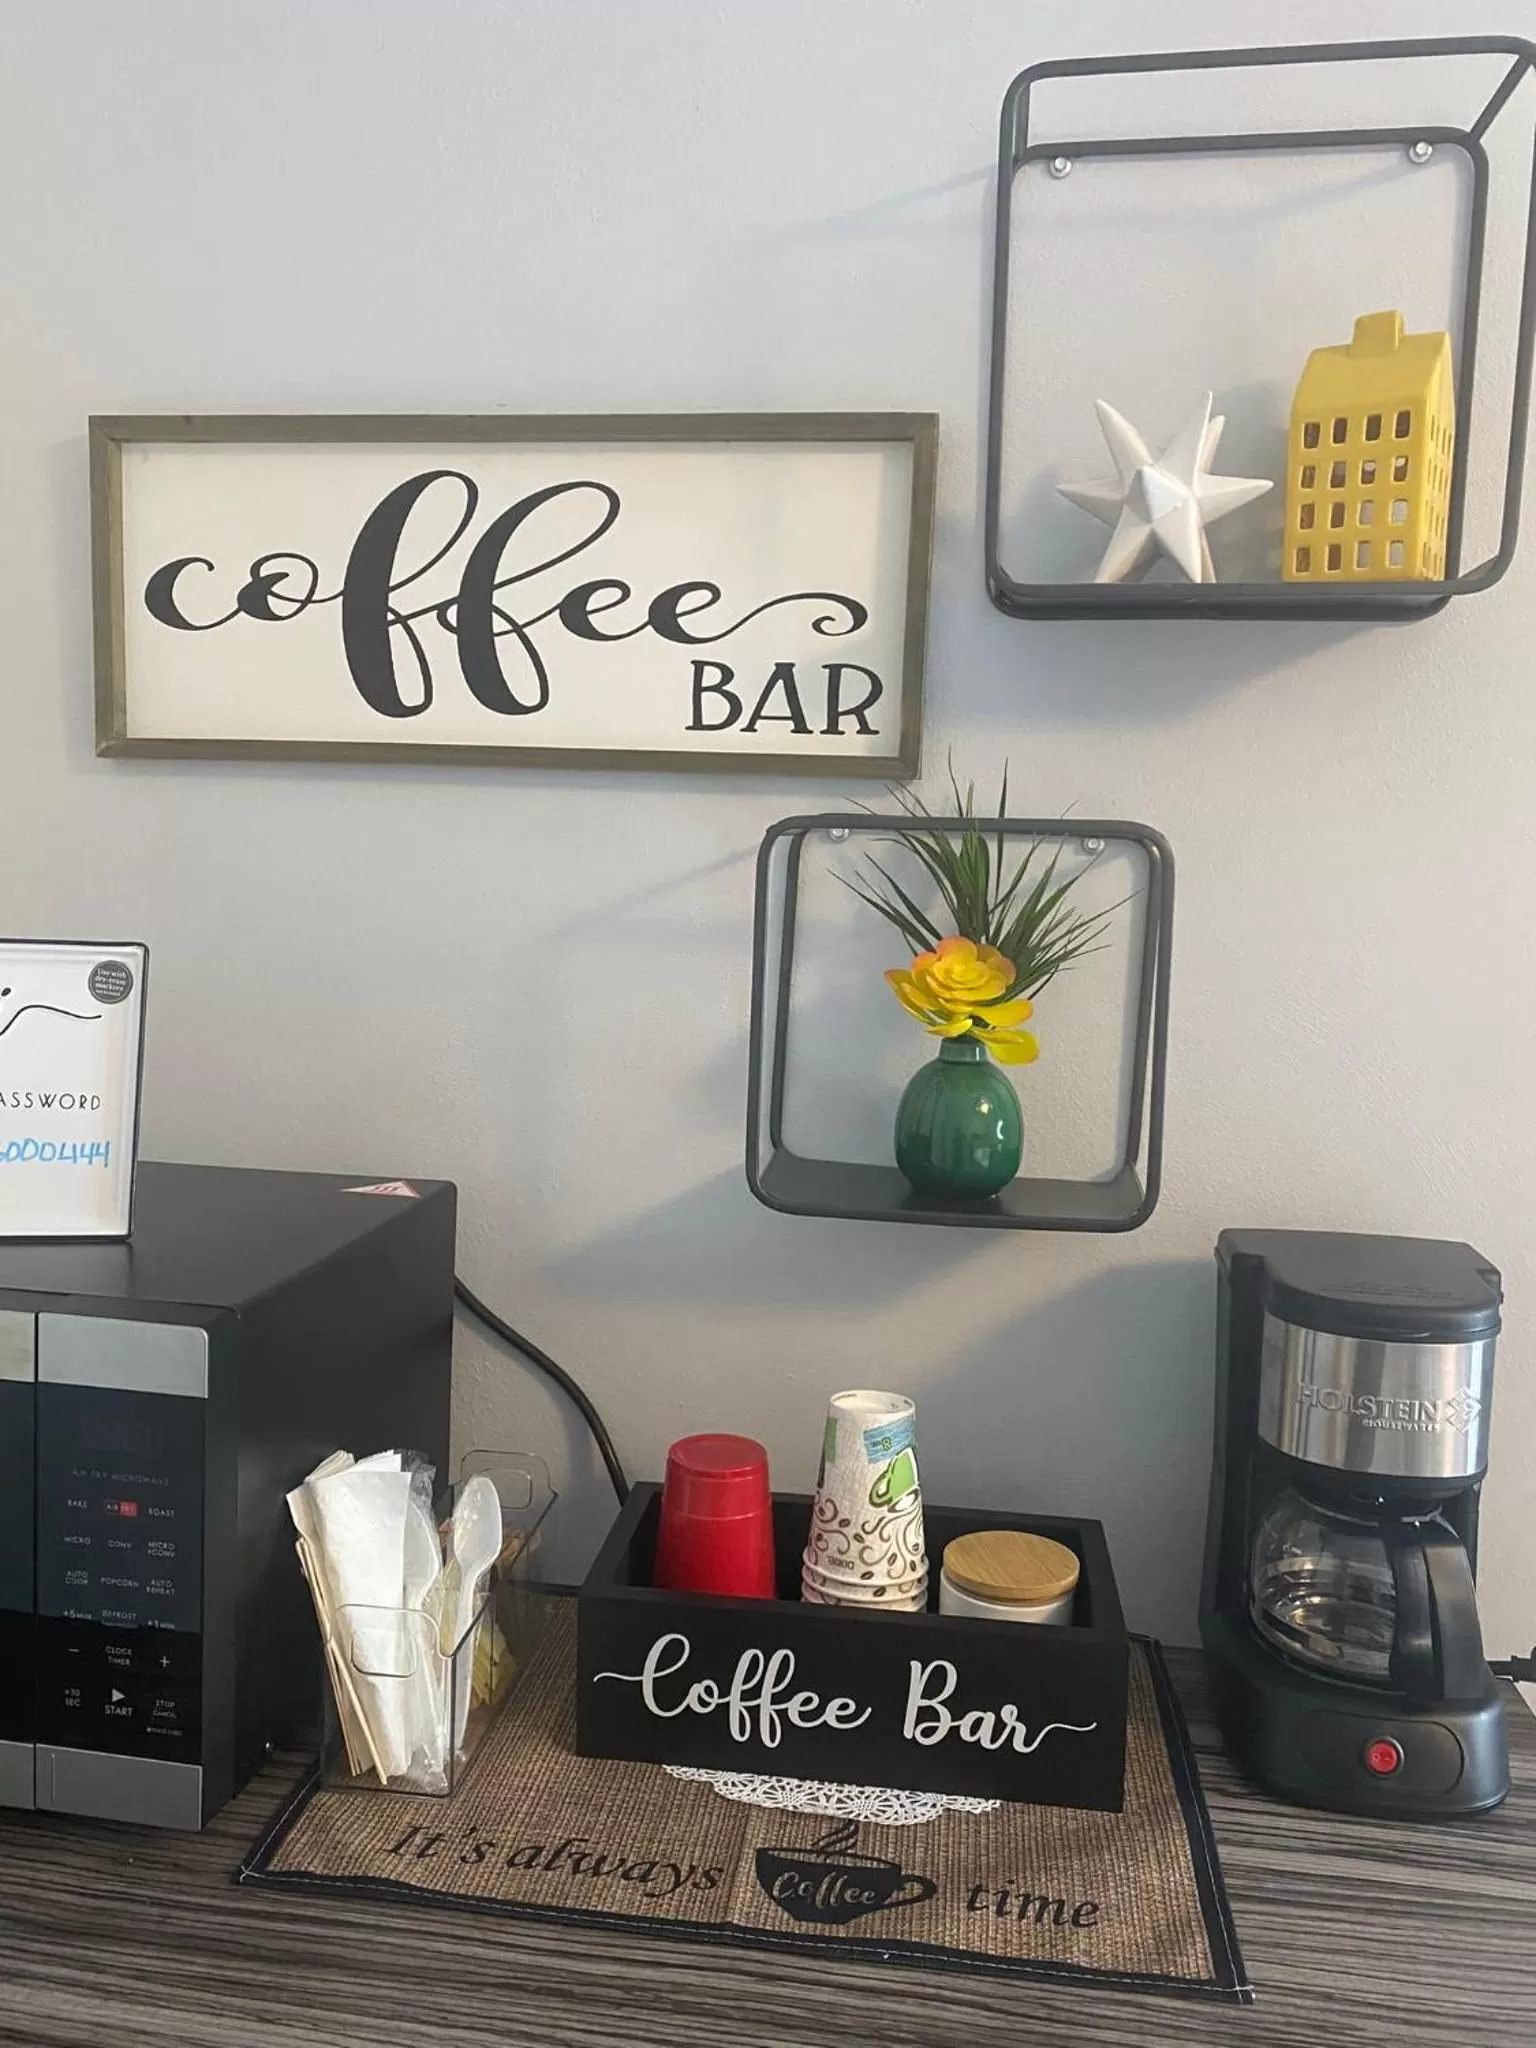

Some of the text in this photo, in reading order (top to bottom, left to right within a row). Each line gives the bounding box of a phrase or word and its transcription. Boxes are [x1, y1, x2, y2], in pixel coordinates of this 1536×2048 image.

[144, 470, 868, 718] coffee
[686, 660, 883, 736] BAR
[1299, 1383, 1441, 1423] HOLSTEIN
[100, 1577, 138, 1588] POPCORN
[101, 1609, 137, 1621] DEFROST
[105, 1646, 132, 1656] CLOCK
[104, 1704, 133, 1718] START
[594, 1633, 1098, 1754] Coffee Bar
[386, 1820, 726, 1898] It's always
[772, 1870, 877, 1910] Coffee
[966, 1880, 1101, 1929] time
